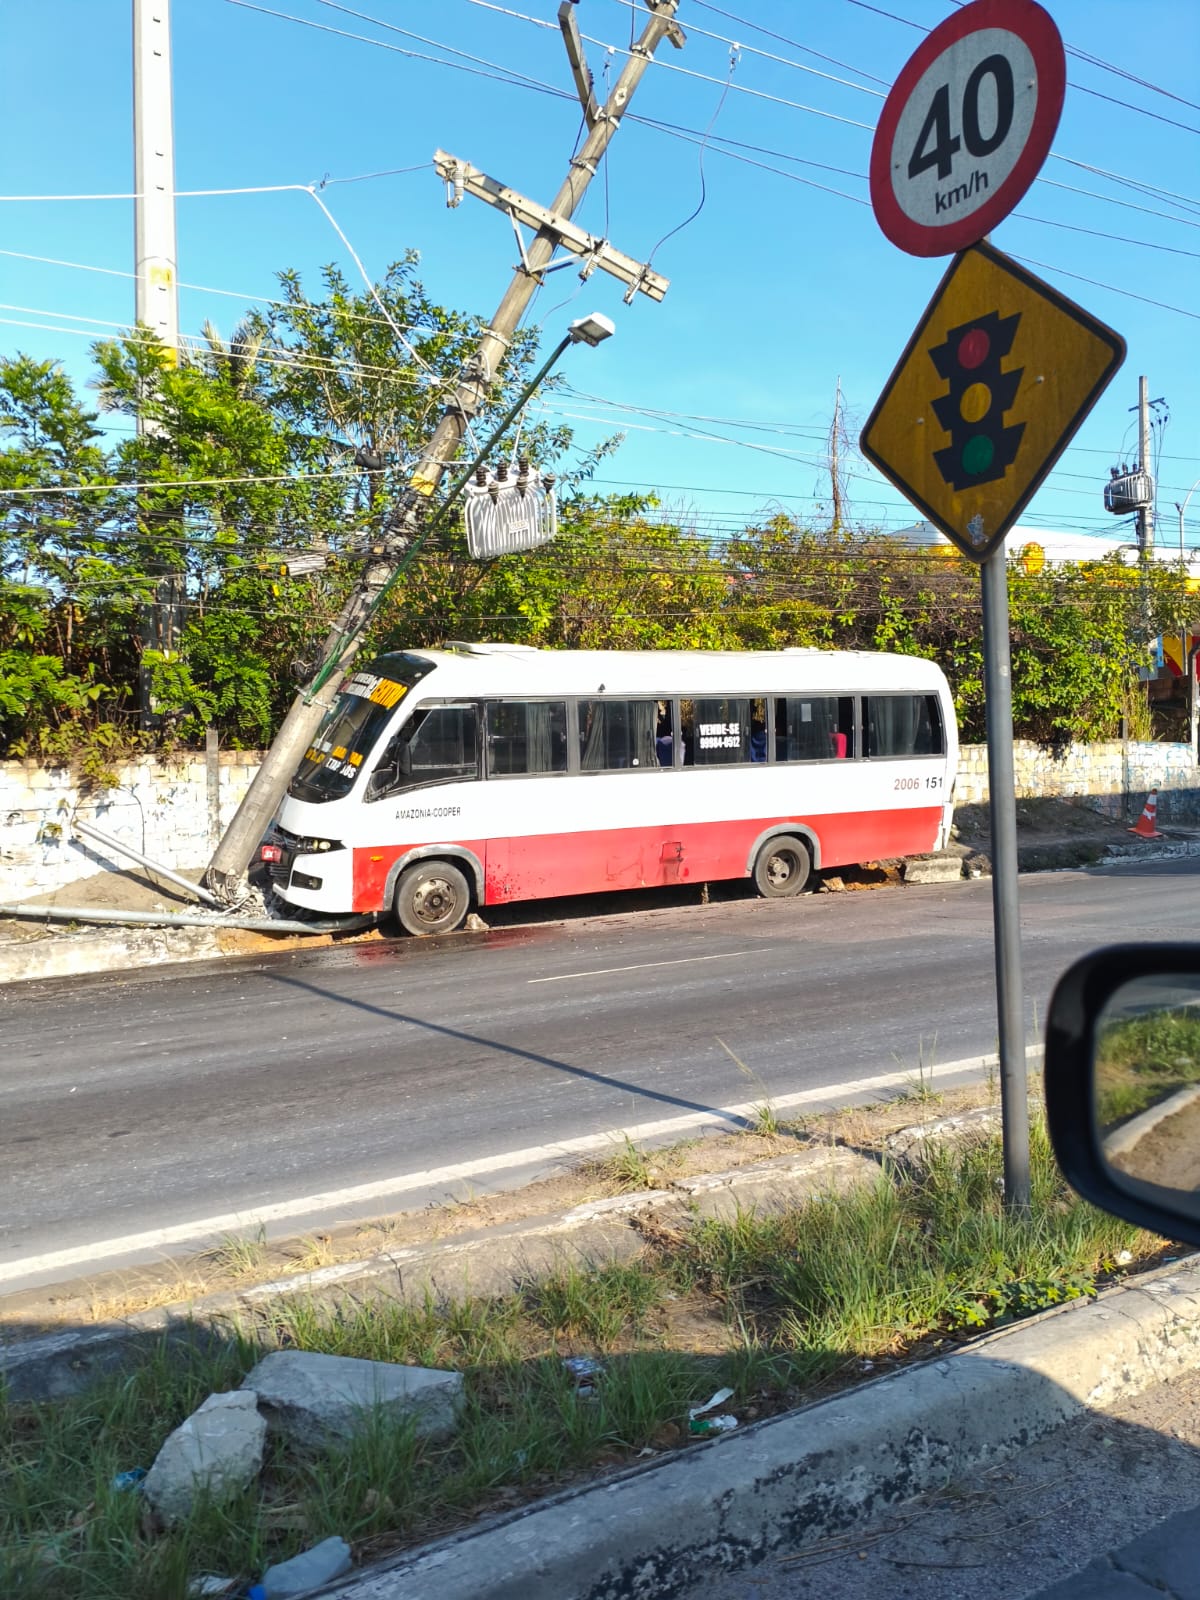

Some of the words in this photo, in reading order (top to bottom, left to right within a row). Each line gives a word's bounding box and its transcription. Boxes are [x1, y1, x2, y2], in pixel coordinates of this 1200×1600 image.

[908, 54, 1015, 180] 40
[935, 170, 989, 214] km/h
[699, 722, 740, 736] VENDE-SE
[894, 777, 920, 790] 2006
[925, 776, 943, 789] 151
[395, 806, 461, 820] AMAZONIA-COOPER
